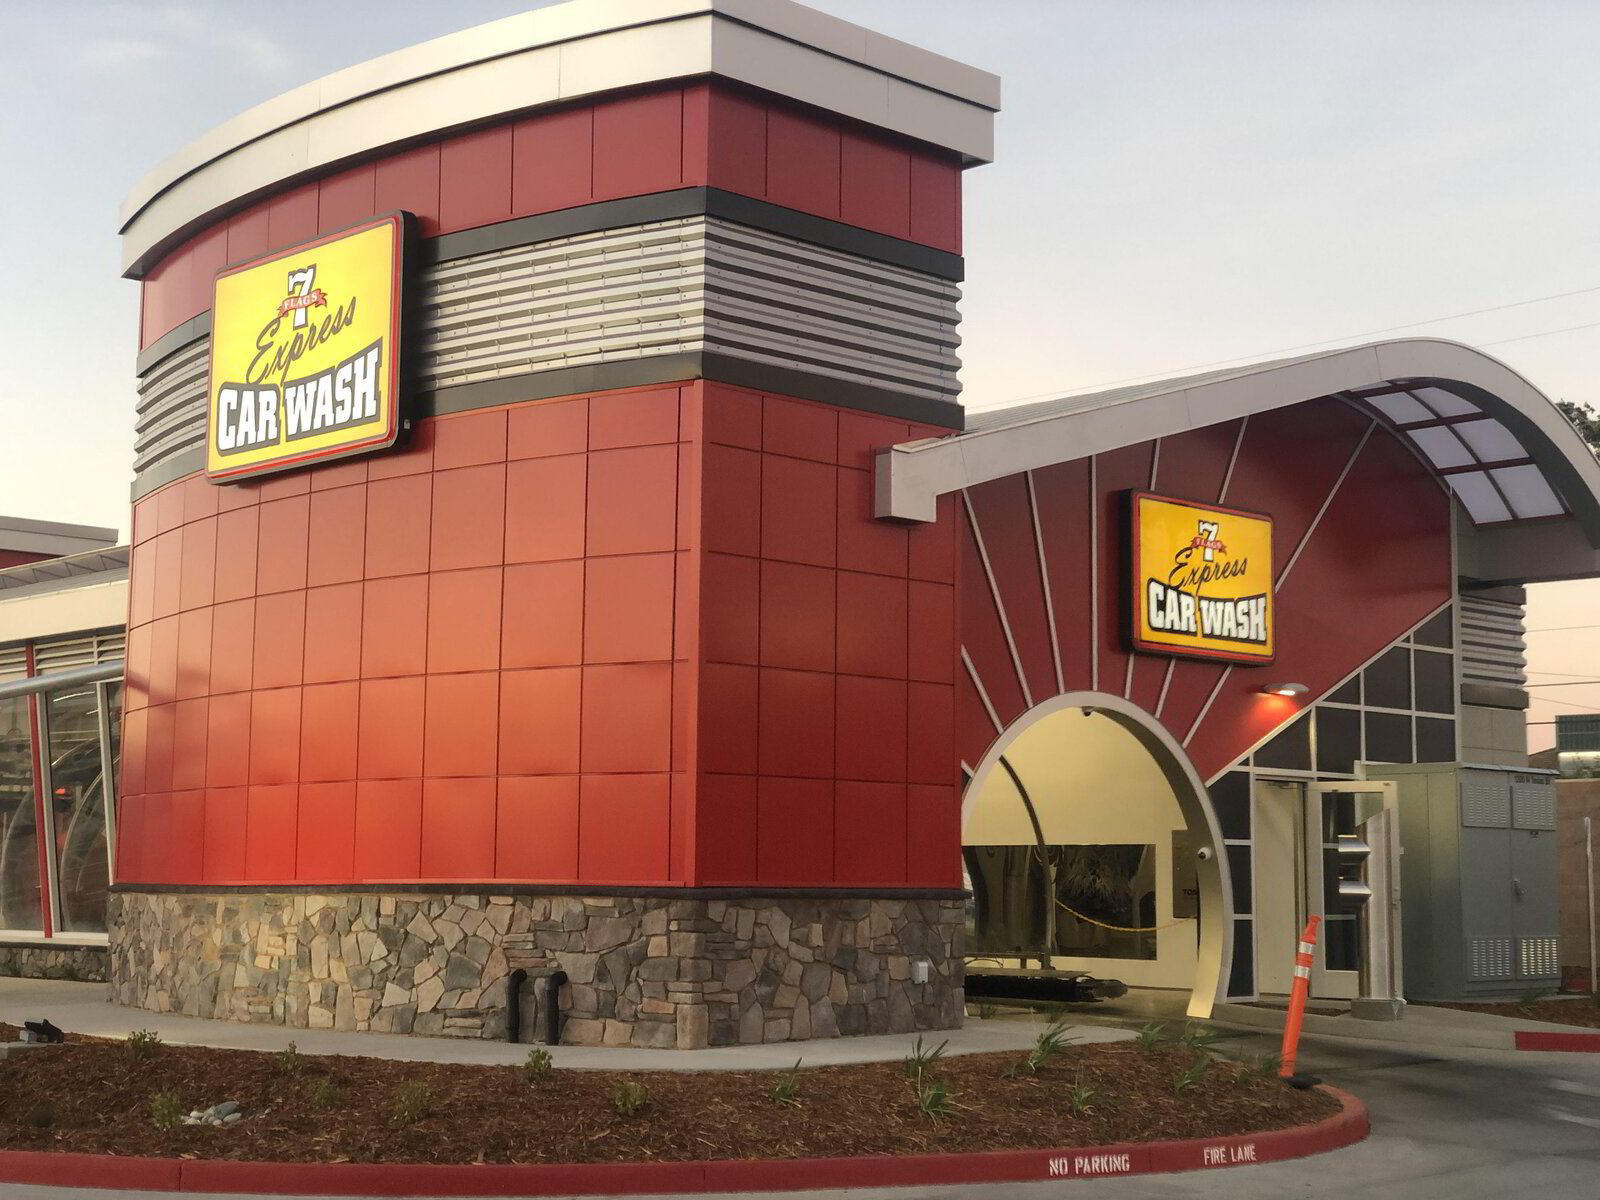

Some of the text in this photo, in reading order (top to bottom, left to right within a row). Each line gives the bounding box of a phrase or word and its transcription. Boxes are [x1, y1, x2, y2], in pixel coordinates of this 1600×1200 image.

[284, 292, 318, 310] FLAGS
[288, 264, 316, 331] 7
[246, 296, 356, 387] Express
[217, 342, 381, 454] CAR WASH
[1198, 520, 1219, 562] 7
[1169, 546, 1248, 596] Express
[1149, 580, 1267, 643] CAR WASH
[1049, 1154, 1130, 1176] NO PARKING
[1204, 1143, 1257, 1166] FIRE LANE
